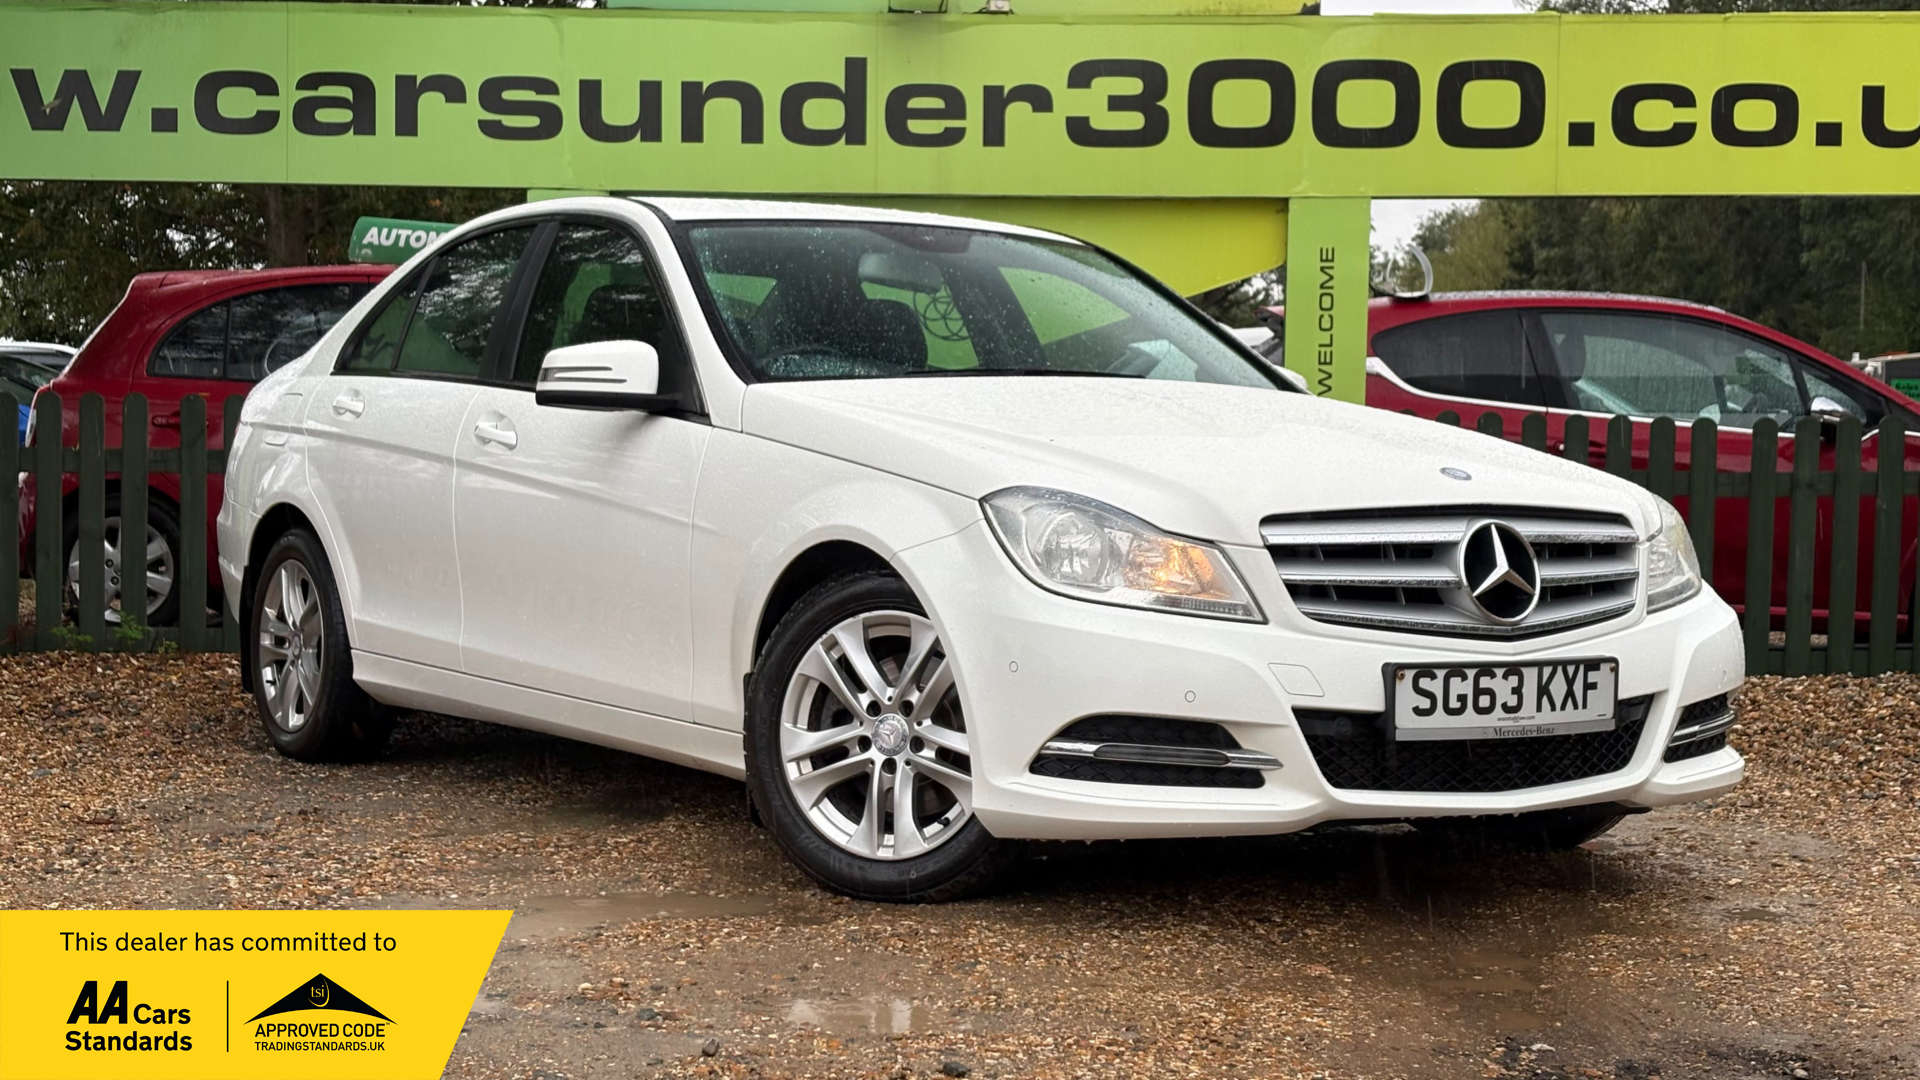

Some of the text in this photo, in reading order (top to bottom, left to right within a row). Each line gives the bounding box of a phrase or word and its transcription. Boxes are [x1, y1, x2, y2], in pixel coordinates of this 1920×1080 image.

[1317, 246, 1335, 397] WELCOME
[1411, 663, 1601, 717] SG63 KXF
[1493, 725, 1556, 738] Mercedes-Benz
